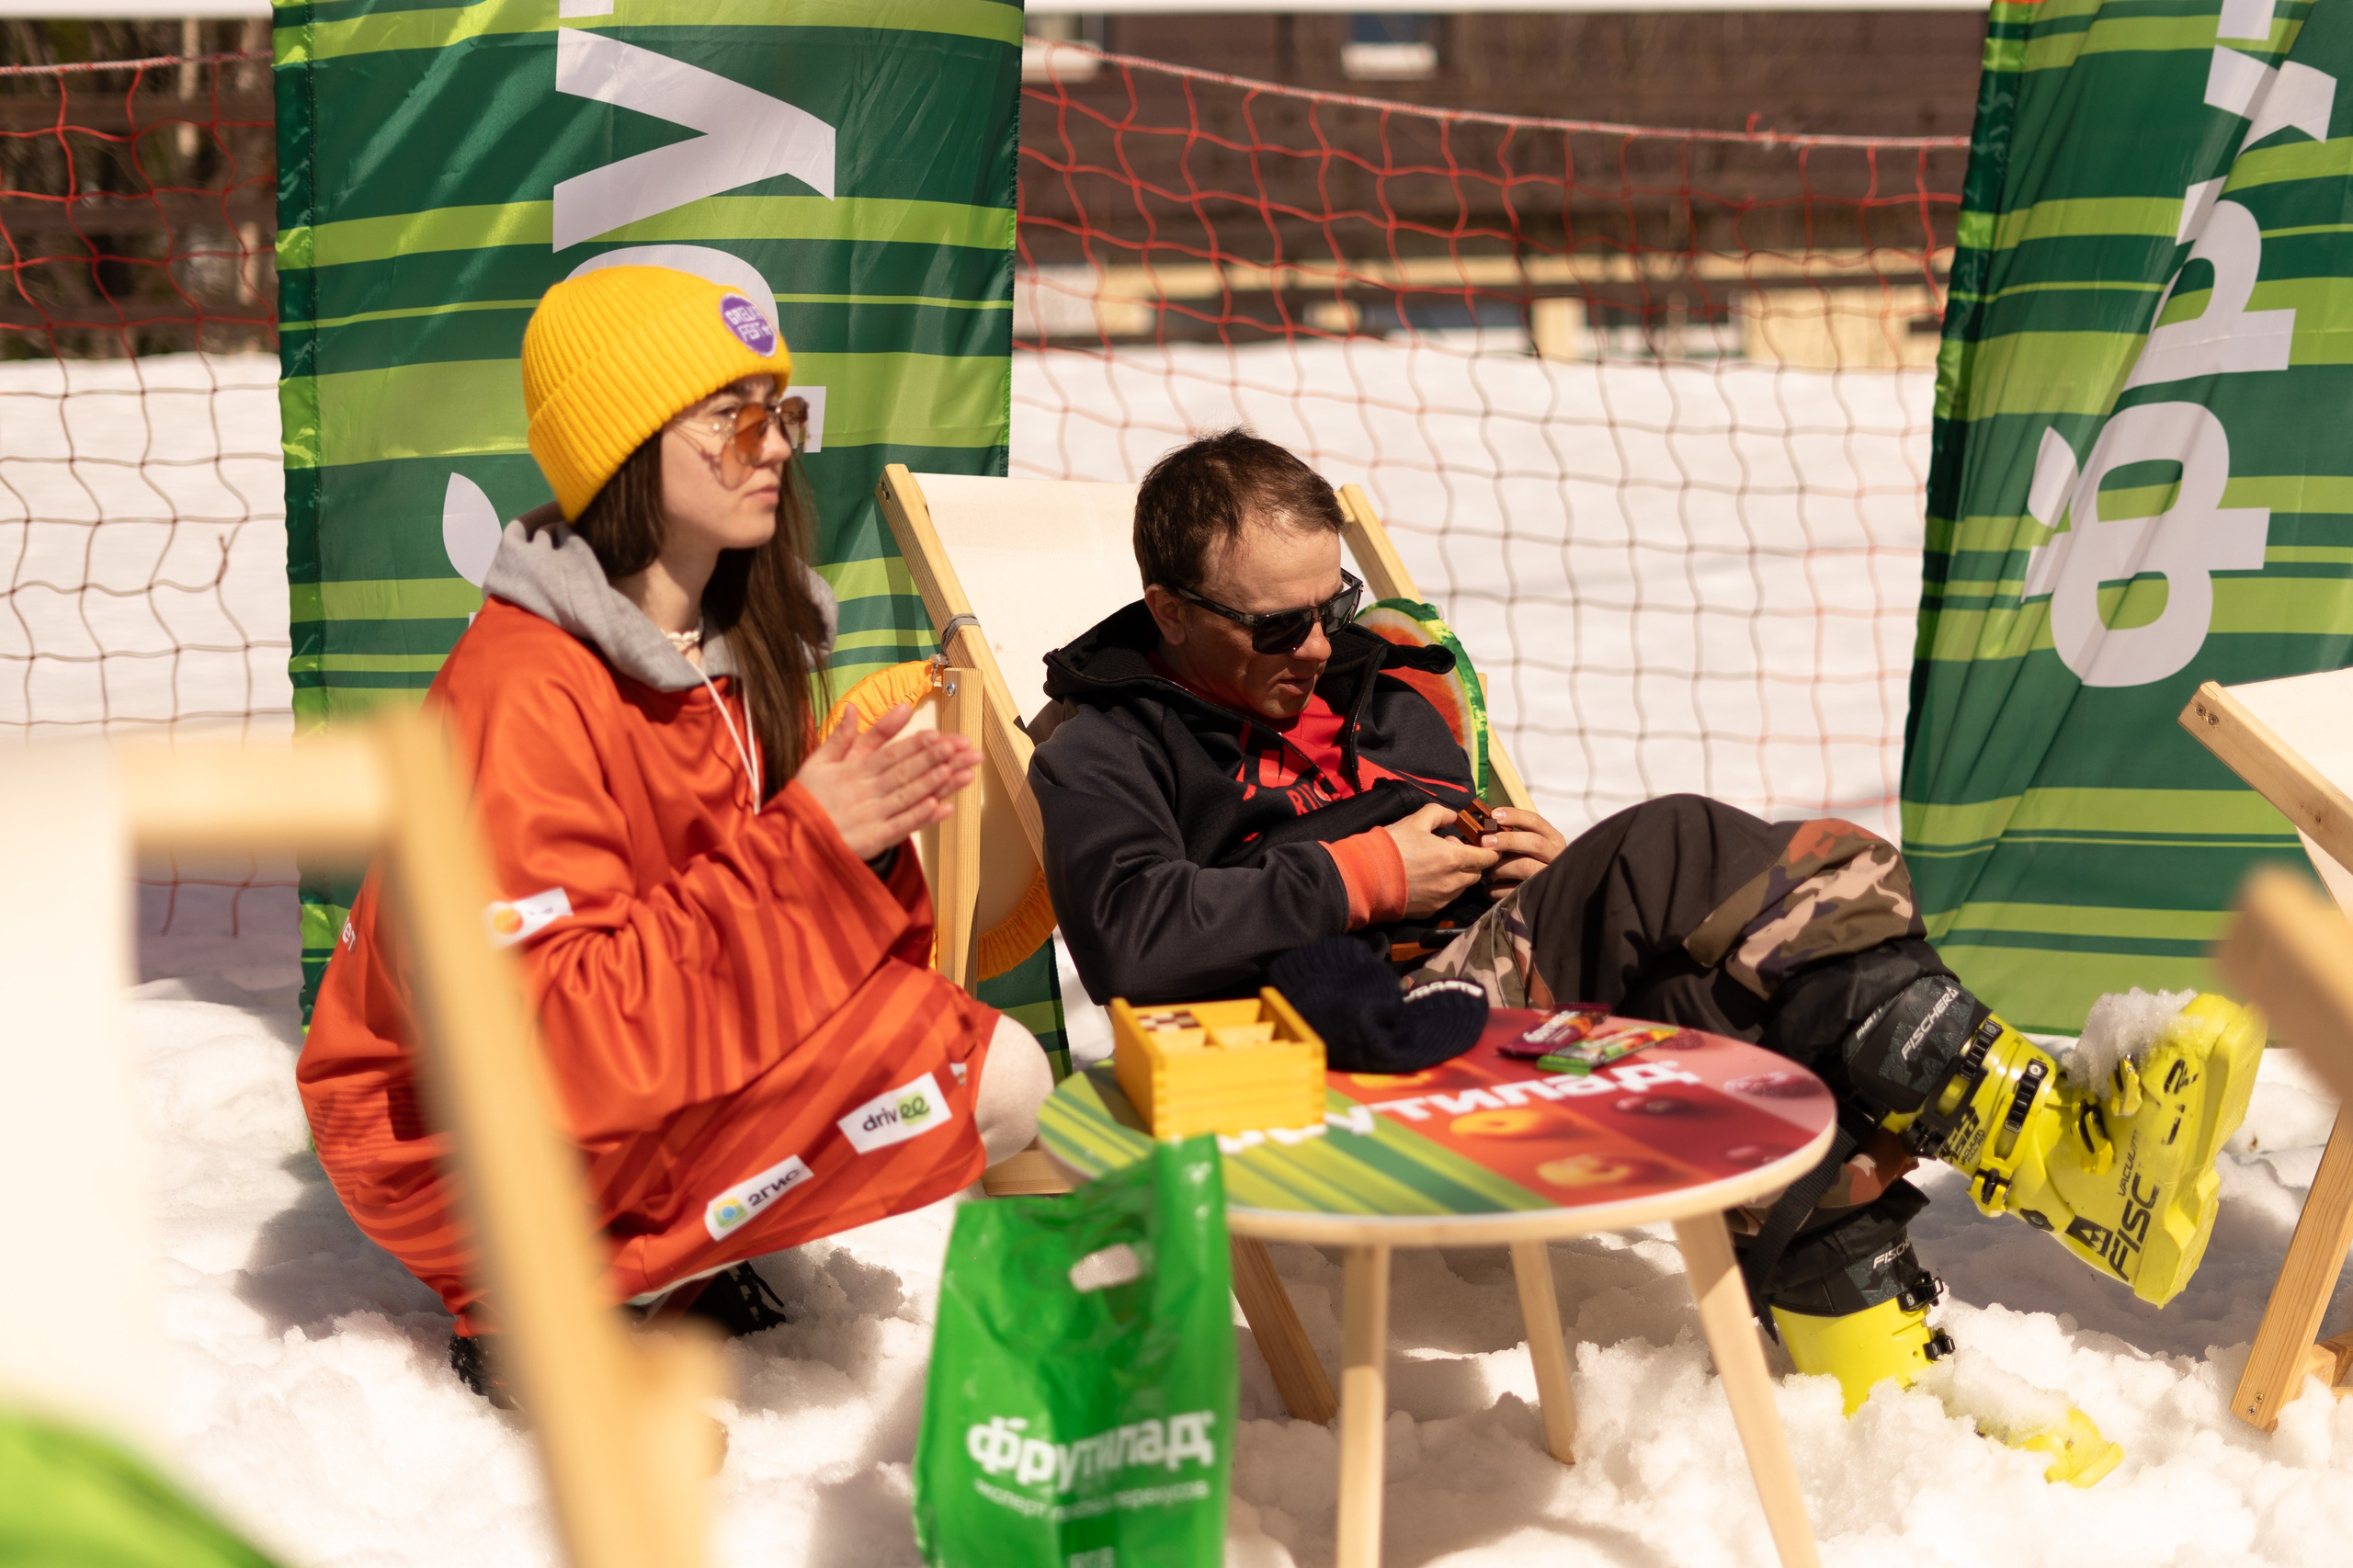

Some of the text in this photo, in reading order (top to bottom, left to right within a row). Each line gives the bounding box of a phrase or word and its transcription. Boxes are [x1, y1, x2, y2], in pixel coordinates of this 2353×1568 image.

[1901, 992, 1955, 1061] FISCHER
[862, 1096, 930, 1132] drivee
[748, 1168, 800, 1208] 2ГИС
